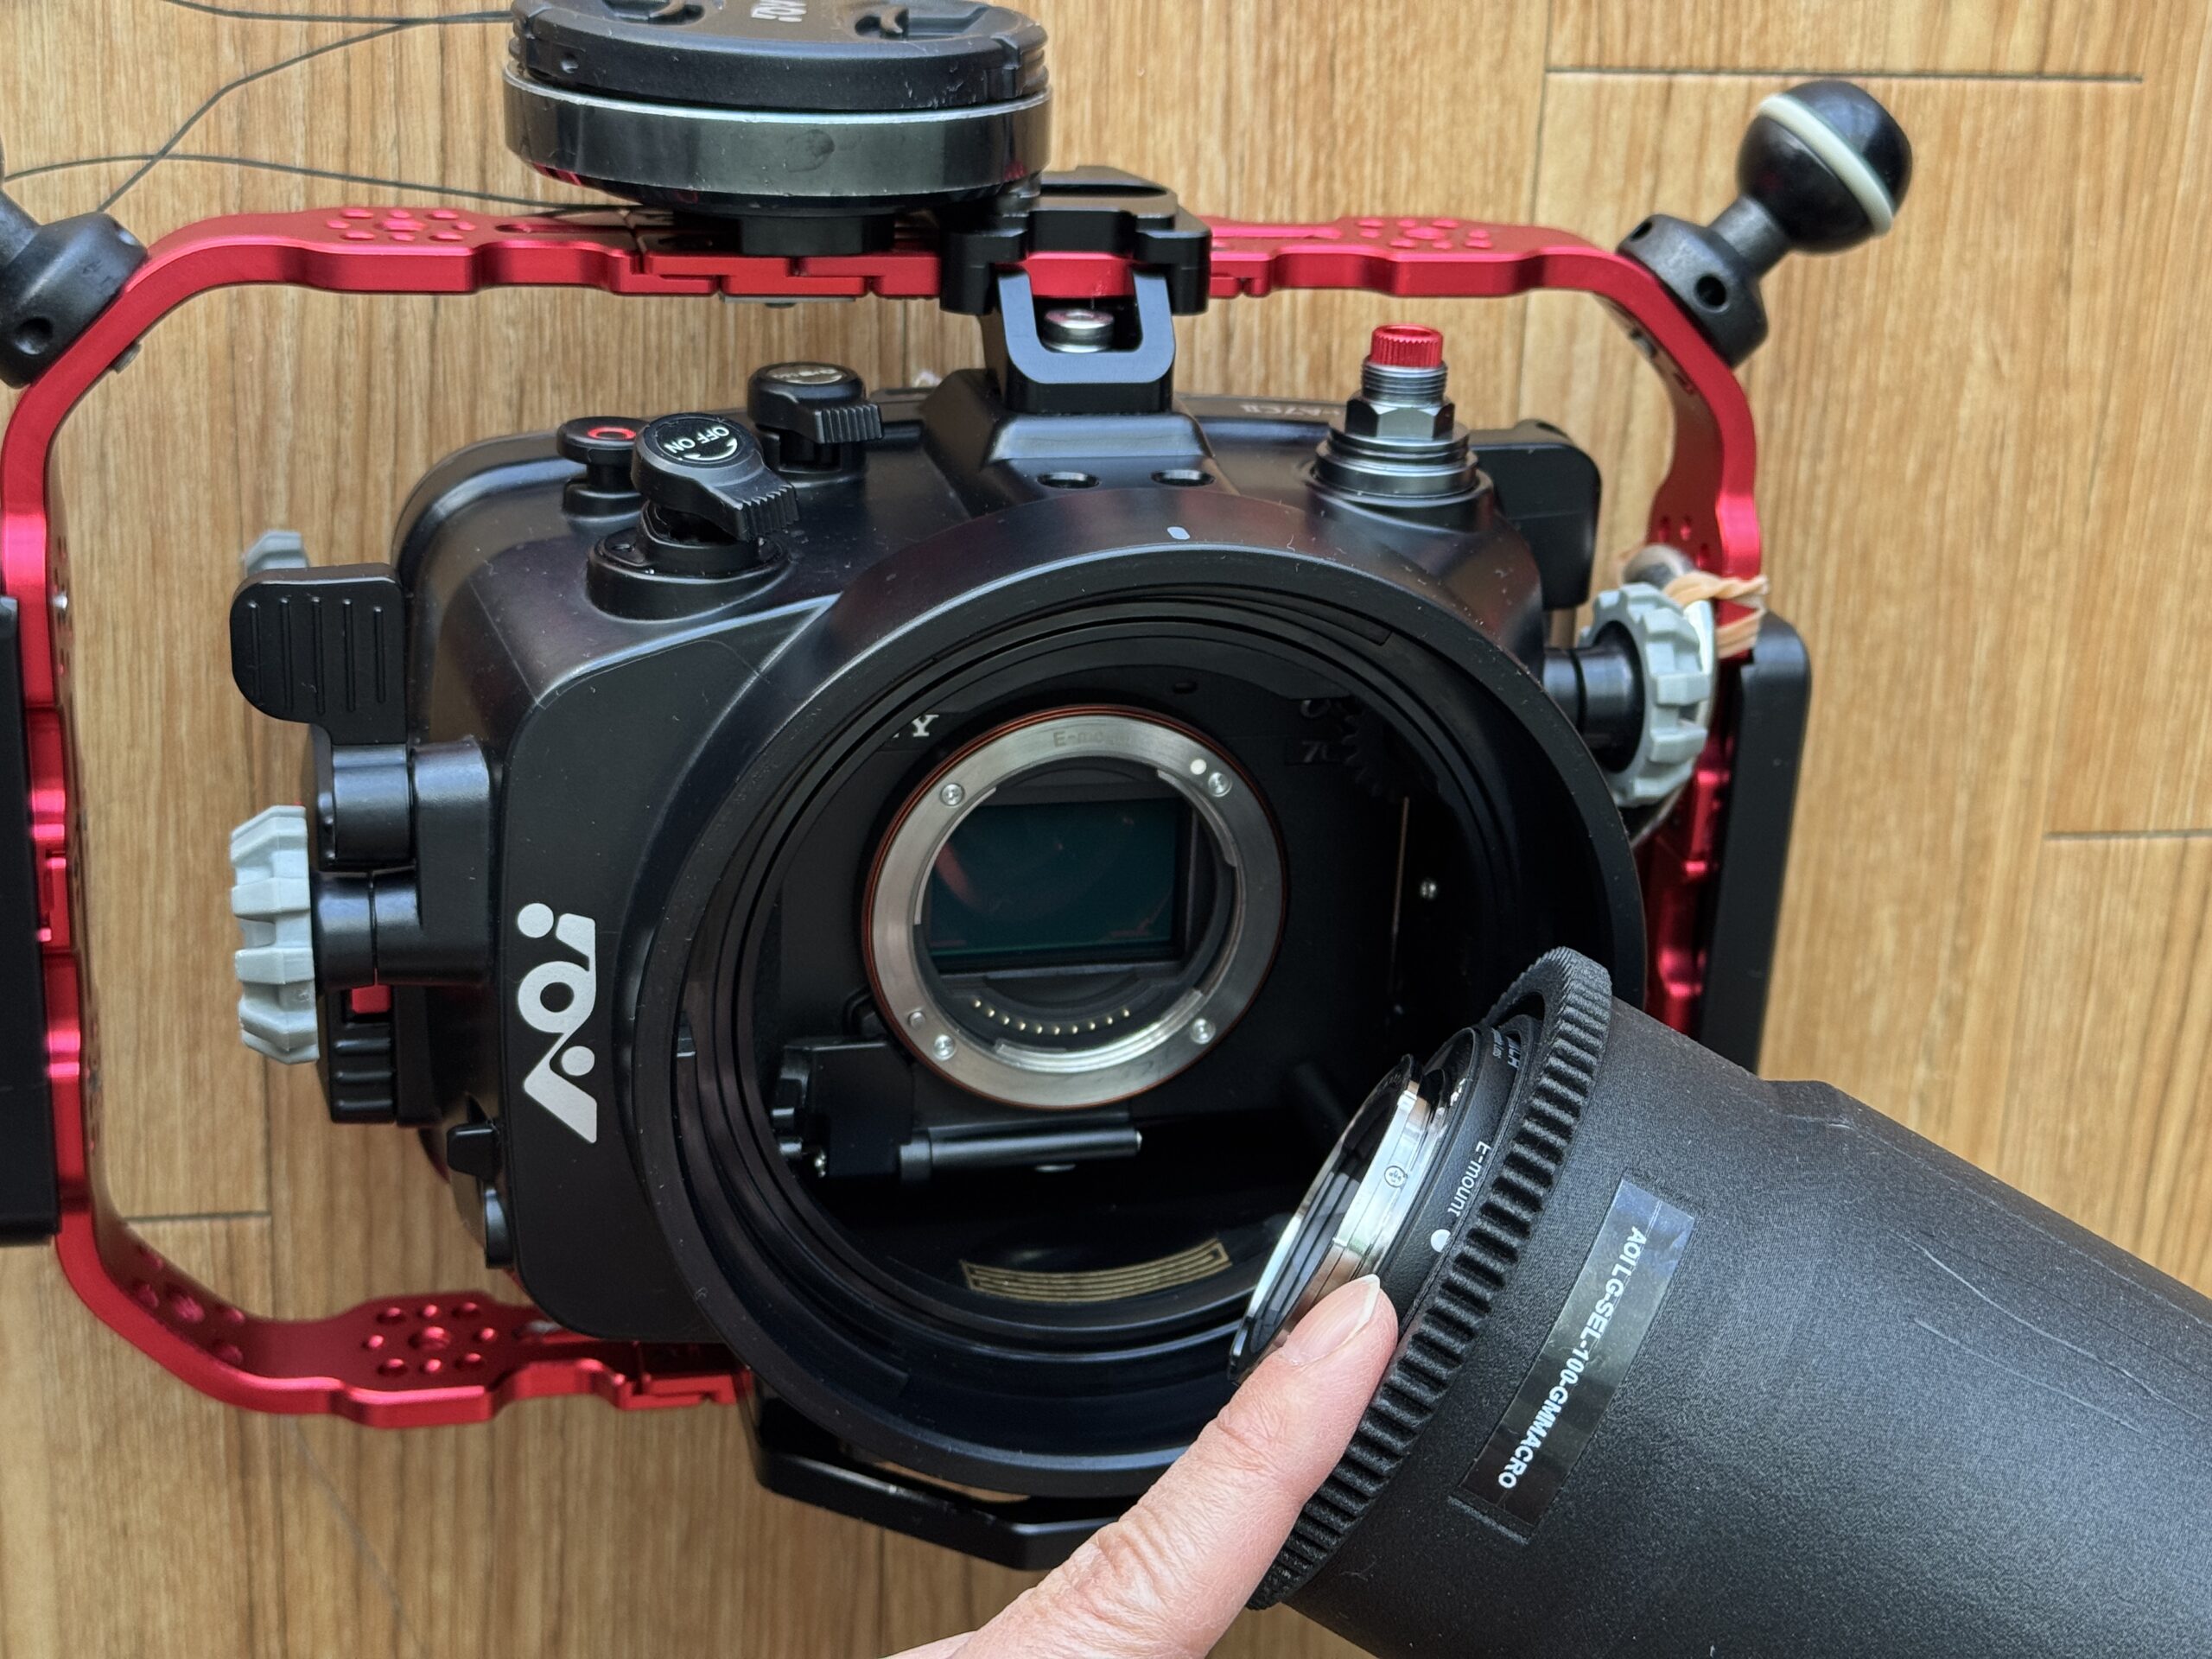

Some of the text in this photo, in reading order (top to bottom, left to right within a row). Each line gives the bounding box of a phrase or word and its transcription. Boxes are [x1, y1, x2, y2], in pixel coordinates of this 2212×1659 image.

[664, 425, 730, 454] OFF ON
[1450, 1141, 1491, 1217] E-mount
[1498, 1226, 1647, 1489] AOI LG-SEL-100-GMMACRO
